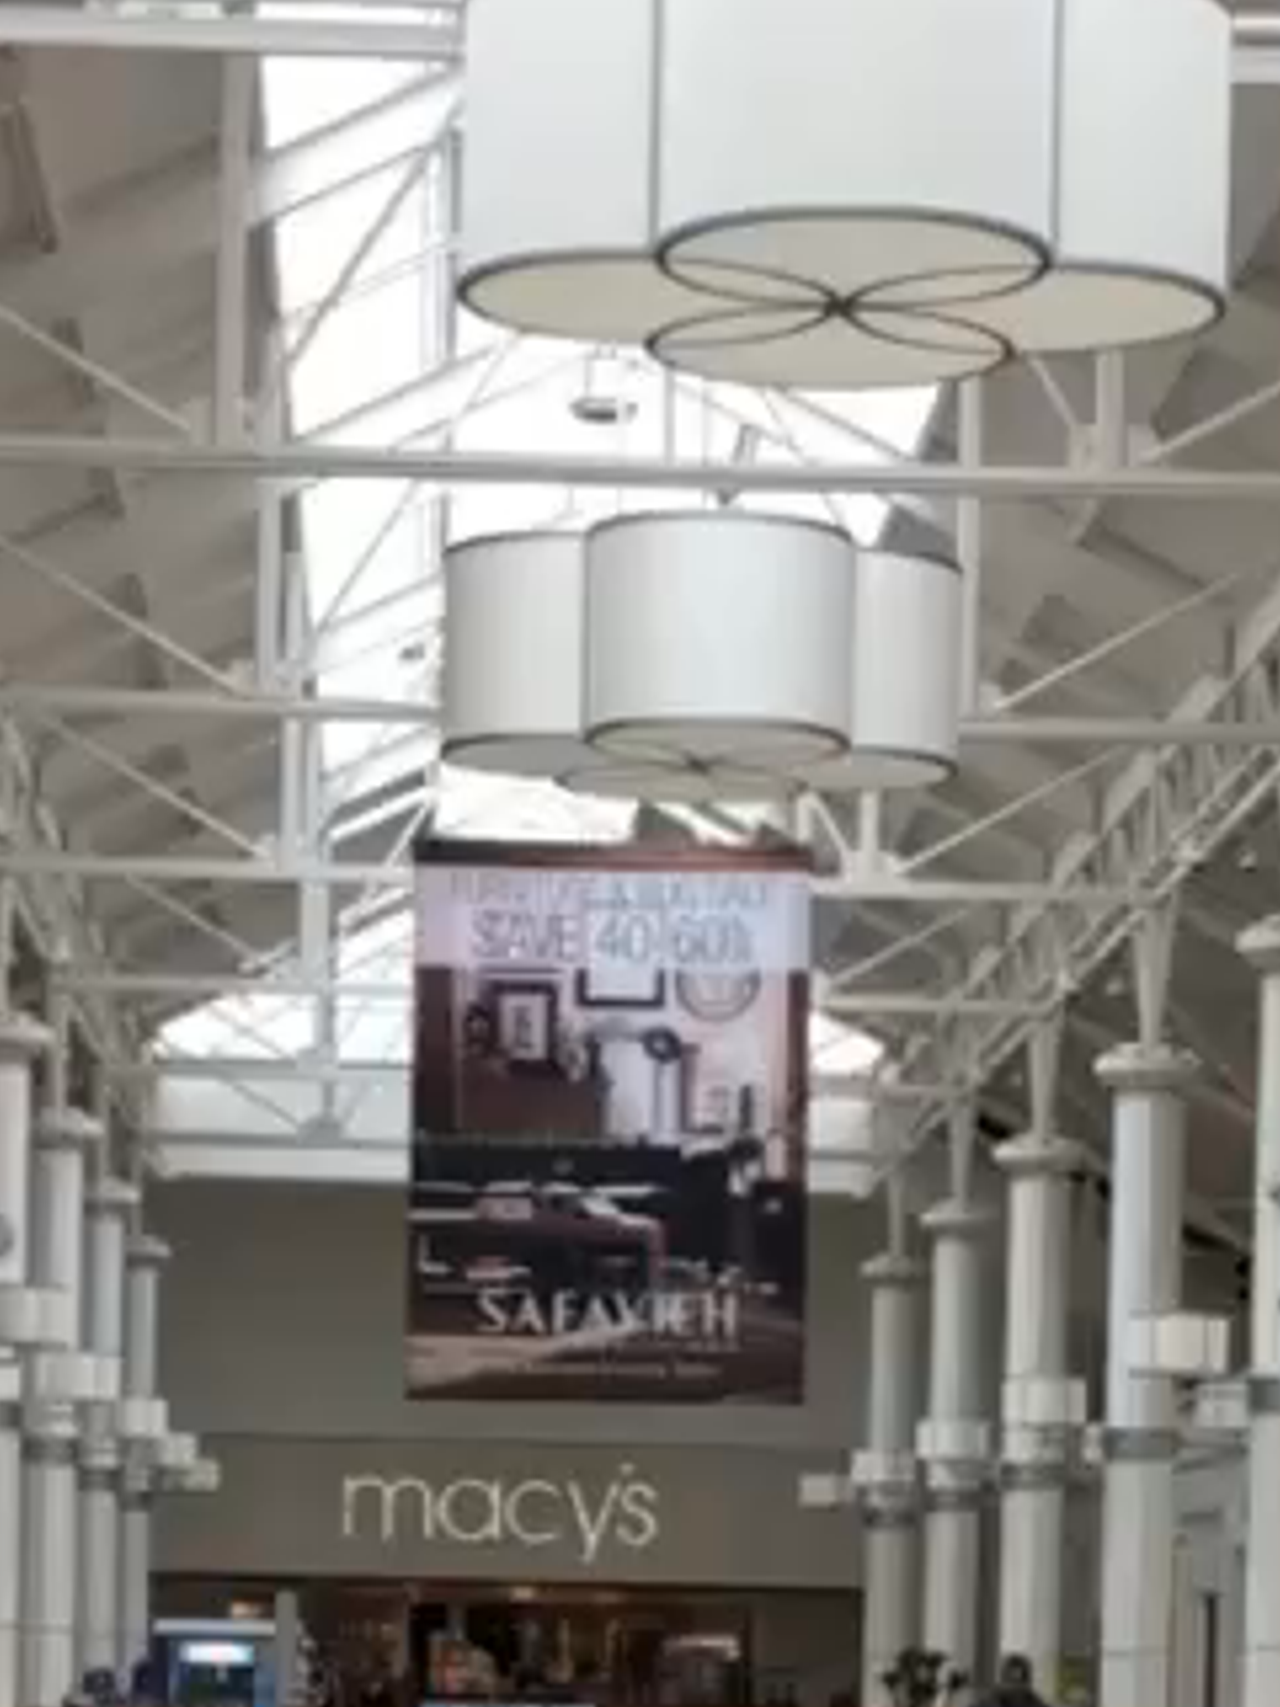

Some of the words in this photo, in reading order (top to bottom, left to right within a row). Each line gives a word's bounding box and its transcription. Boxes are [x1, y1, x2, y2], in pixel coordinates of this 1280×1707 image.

[471, 908, 581, 962] SAVE
[476, 1287, 740, 1338] SAFAVIEH
[342, 1461, 657, 1563] macy's
